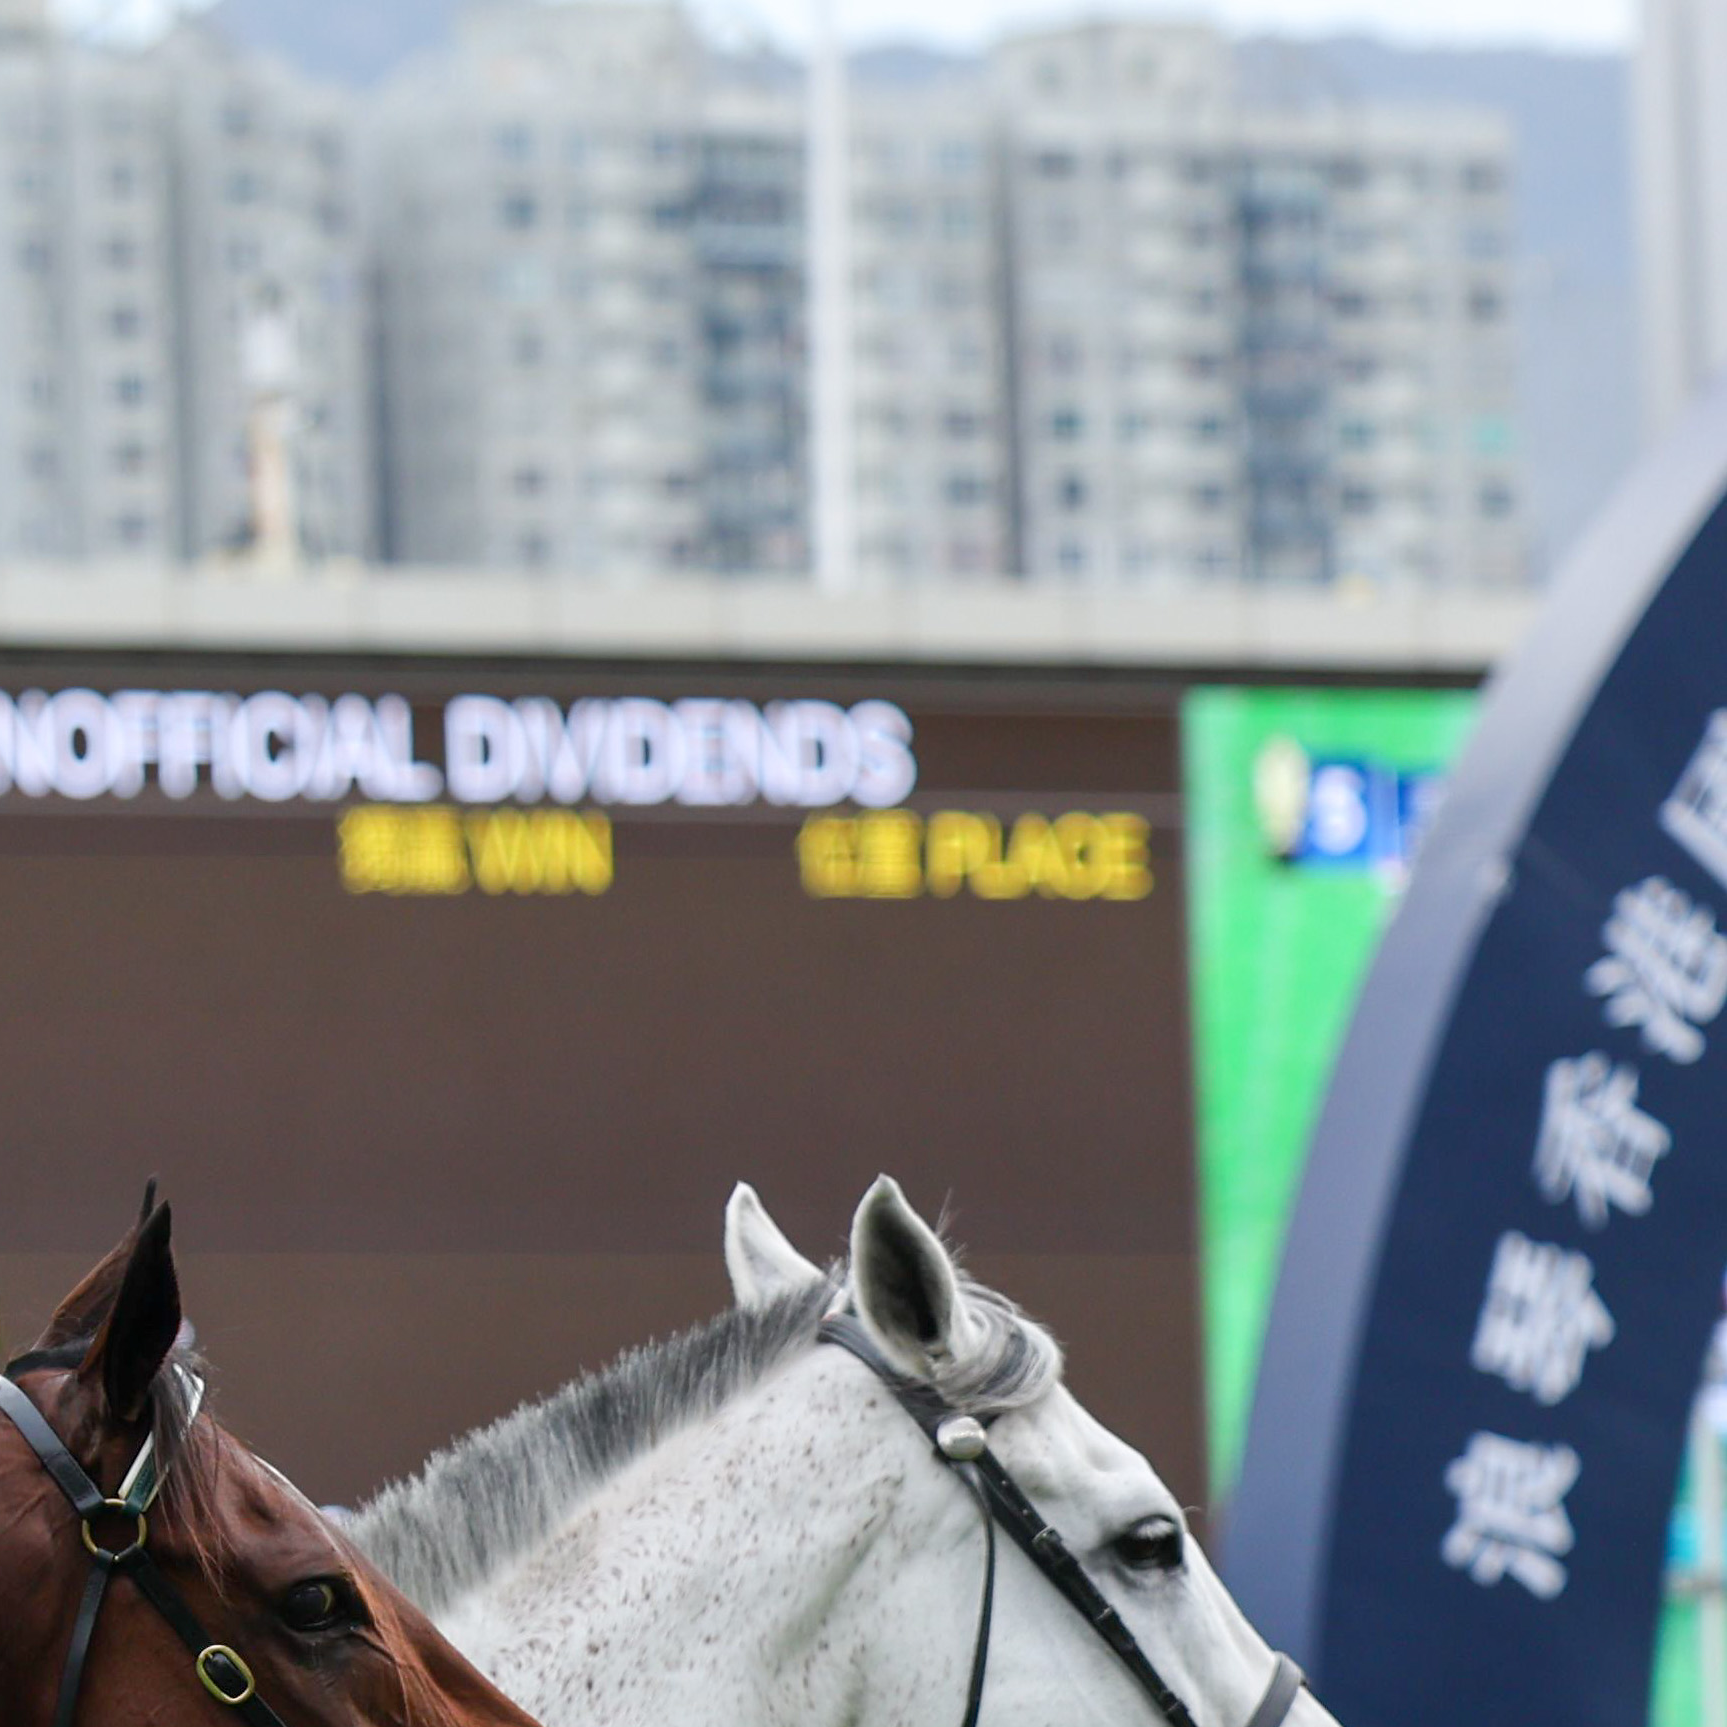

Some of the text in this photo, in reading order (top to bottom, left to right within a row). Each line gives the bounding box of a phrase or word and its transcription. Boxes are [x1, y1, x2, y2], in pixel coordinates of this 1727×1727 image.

[444, 693, 916, 807] DIVIDENDS
[467, 807, 613, 896] WIN
[925, 811, 1153, 900] PLACE
